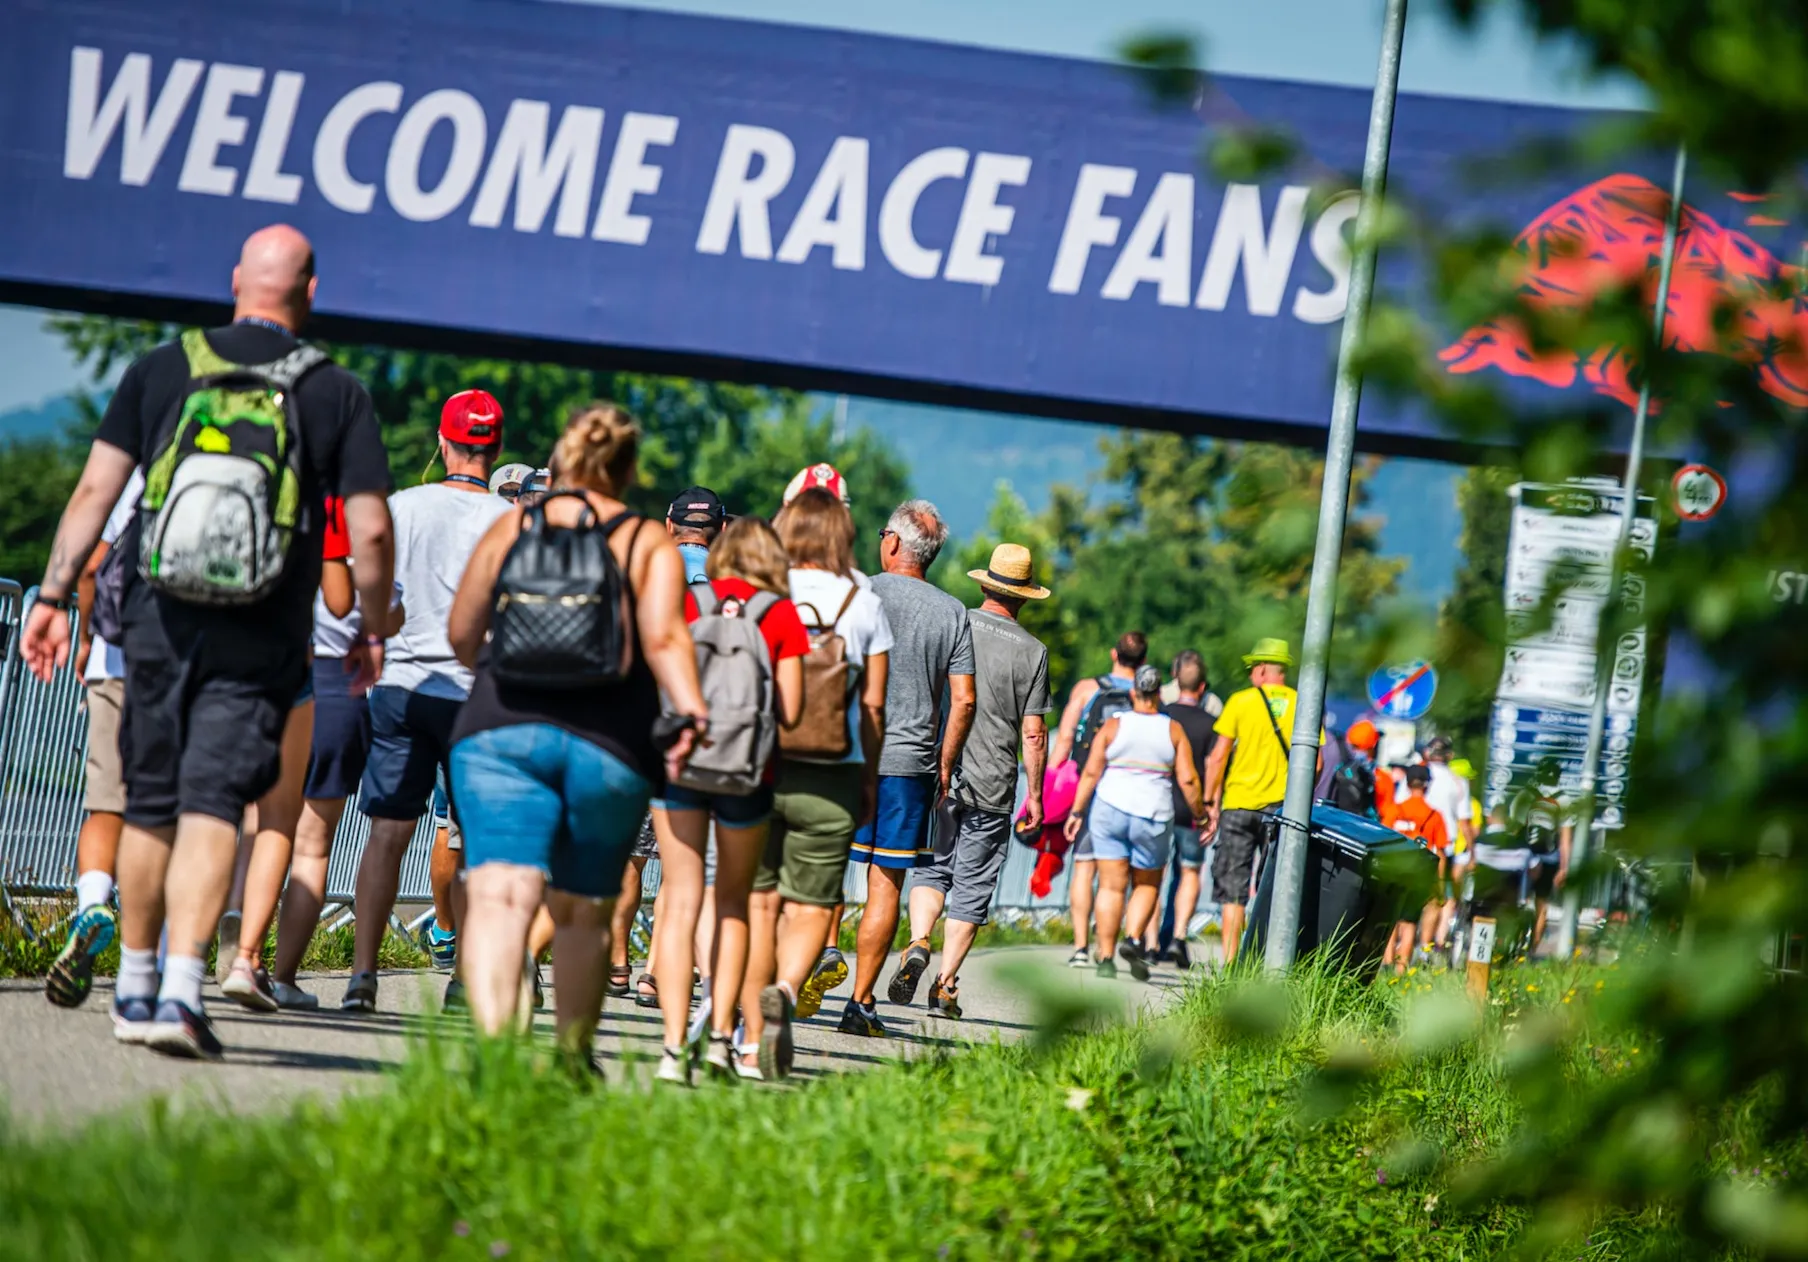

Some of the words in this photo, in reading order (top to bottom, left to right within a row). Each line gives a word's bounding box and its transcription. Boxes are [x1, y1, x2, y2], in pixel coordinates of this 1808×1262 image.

[63, 46, 679, 245] WELCOME
[695, 123, 1032, 286] RACE
[1048, 163, 1361, 324] FANS
[1479, 926, 1488, 941] 4
